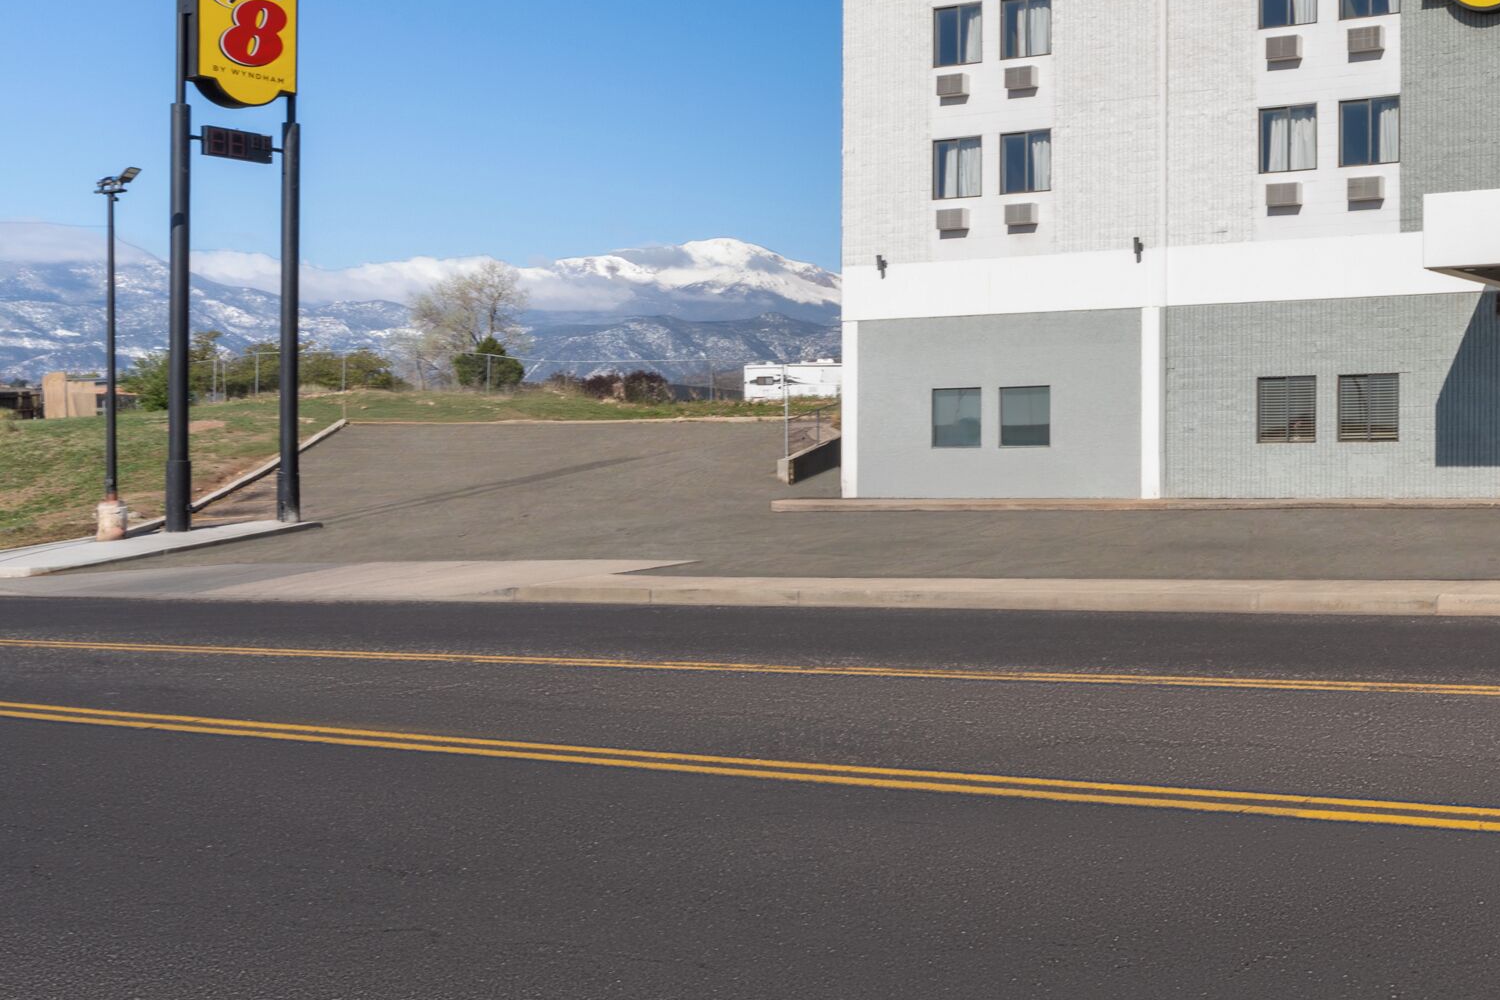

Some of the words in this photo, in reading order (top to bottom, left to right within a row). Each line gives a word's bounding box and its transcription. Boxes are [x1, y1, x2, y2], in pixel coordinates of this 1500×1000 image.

[220, 0, 287, 67] 8
[213, 64, 226, 72] BY
[231, 68, 285, 84] WYNDHAM
